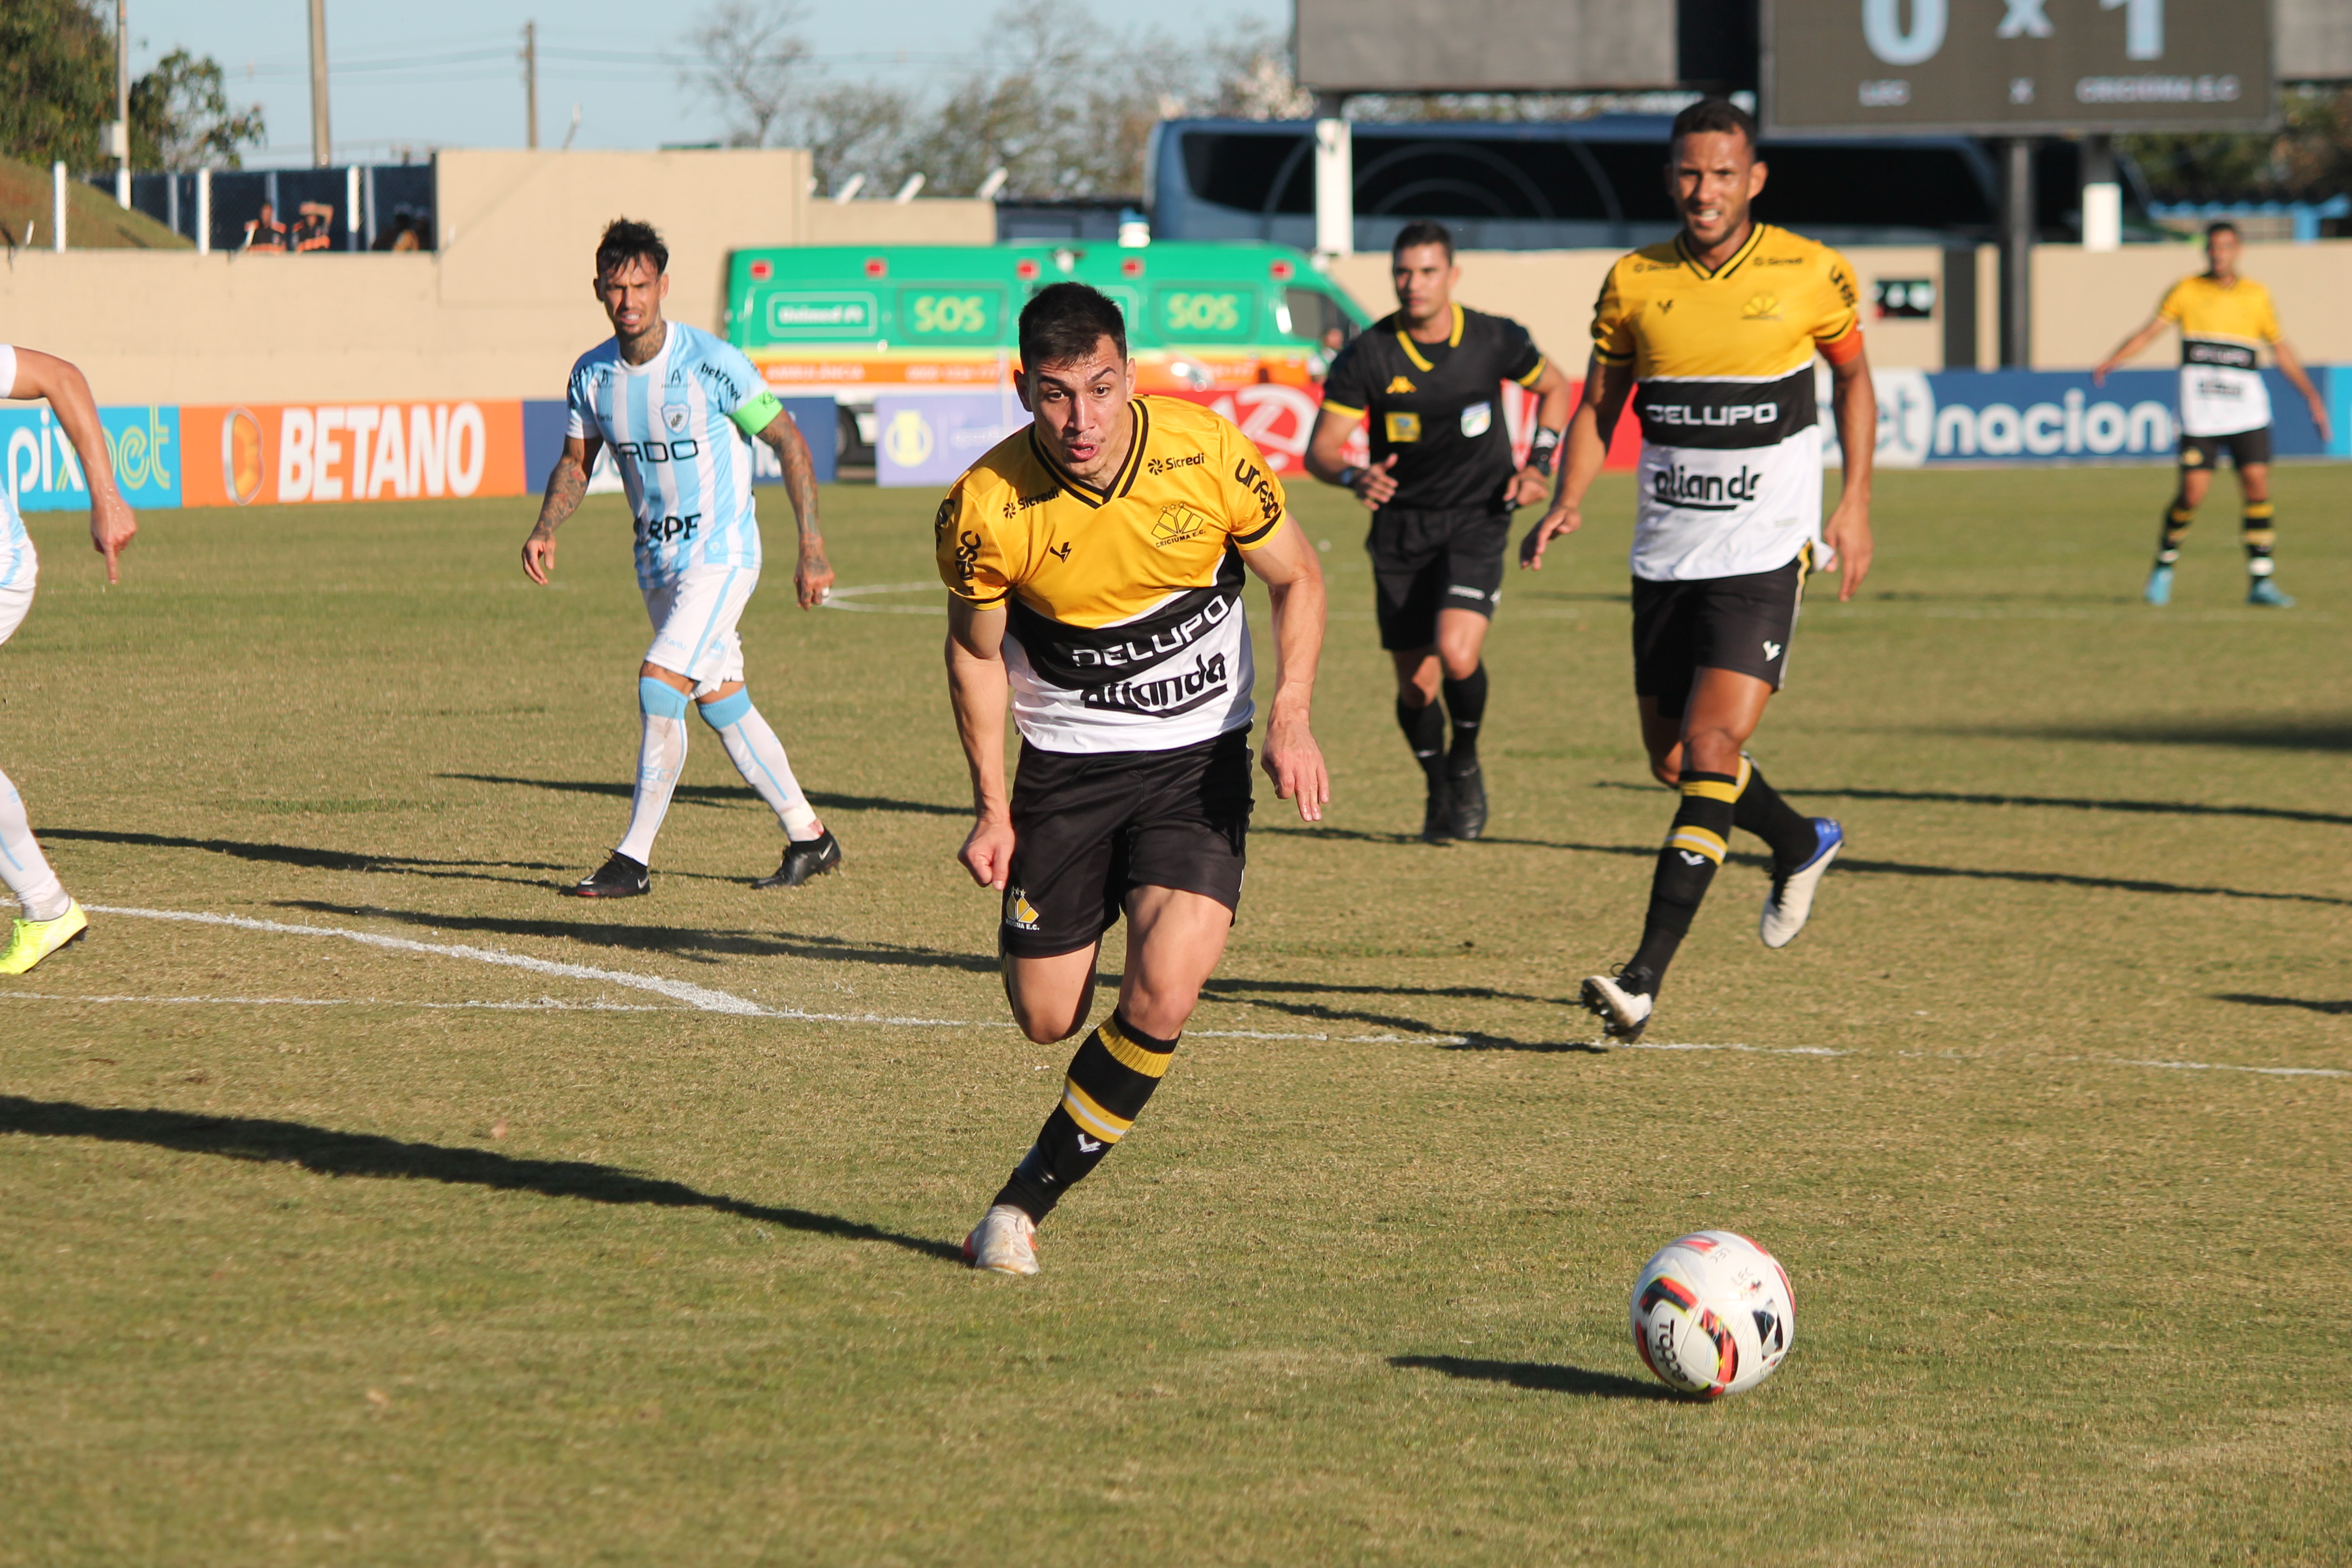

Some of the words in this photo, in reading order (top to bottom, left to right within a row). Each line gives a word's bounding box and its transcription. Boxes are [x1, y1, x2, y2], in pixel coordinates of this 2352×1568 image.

[1862, 0, 1948, 65] 0
[2100, 0, 2165, 61] 1
[914, 295, 986, 333] SOS
[1167, 292, 1239, 330] SOS
[1934, 386, 2181, 456] nacion
[277, 402, 487, 504] BETANO
[1165, 452, 1205, 471] Sicredi
[1017, 485, 1060, 511] Sicredi
[1072, 594, 1229, 667] DELUPO
